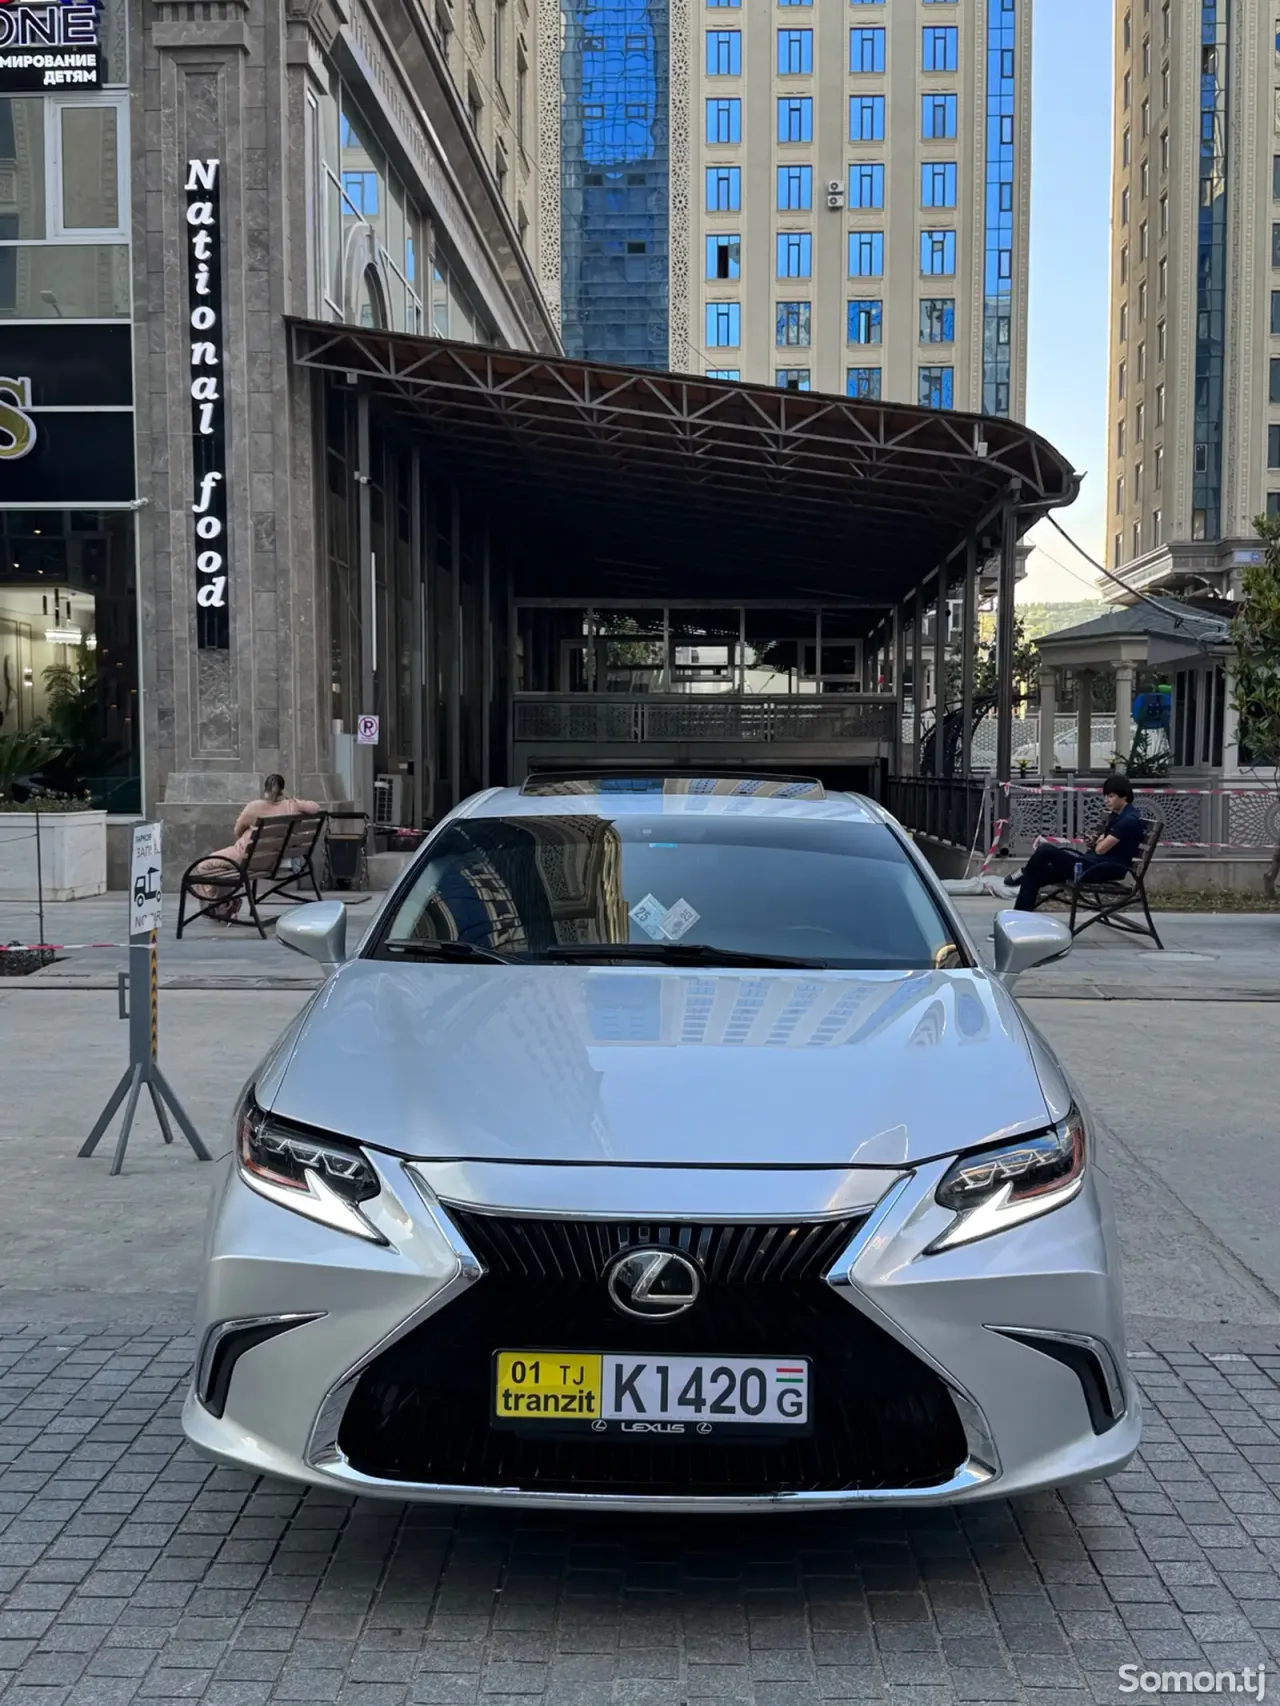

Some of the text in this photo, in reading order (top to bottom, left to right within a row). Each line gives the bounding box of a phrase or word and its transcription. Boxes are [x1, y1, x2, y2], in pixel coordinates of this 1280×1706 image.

[43, 70, 97, 86] ДЕТЯМ
[184, 158, 227, 608] National food
[511, 1360, 585, 1386] 01 TJ
[502, 1388, 596, 1413] tranzit
[613, 1363, 767, 1416] K1420
[776, 1388, 804, 1418] G
[621, 1421, 685, 1434] LEXUS
